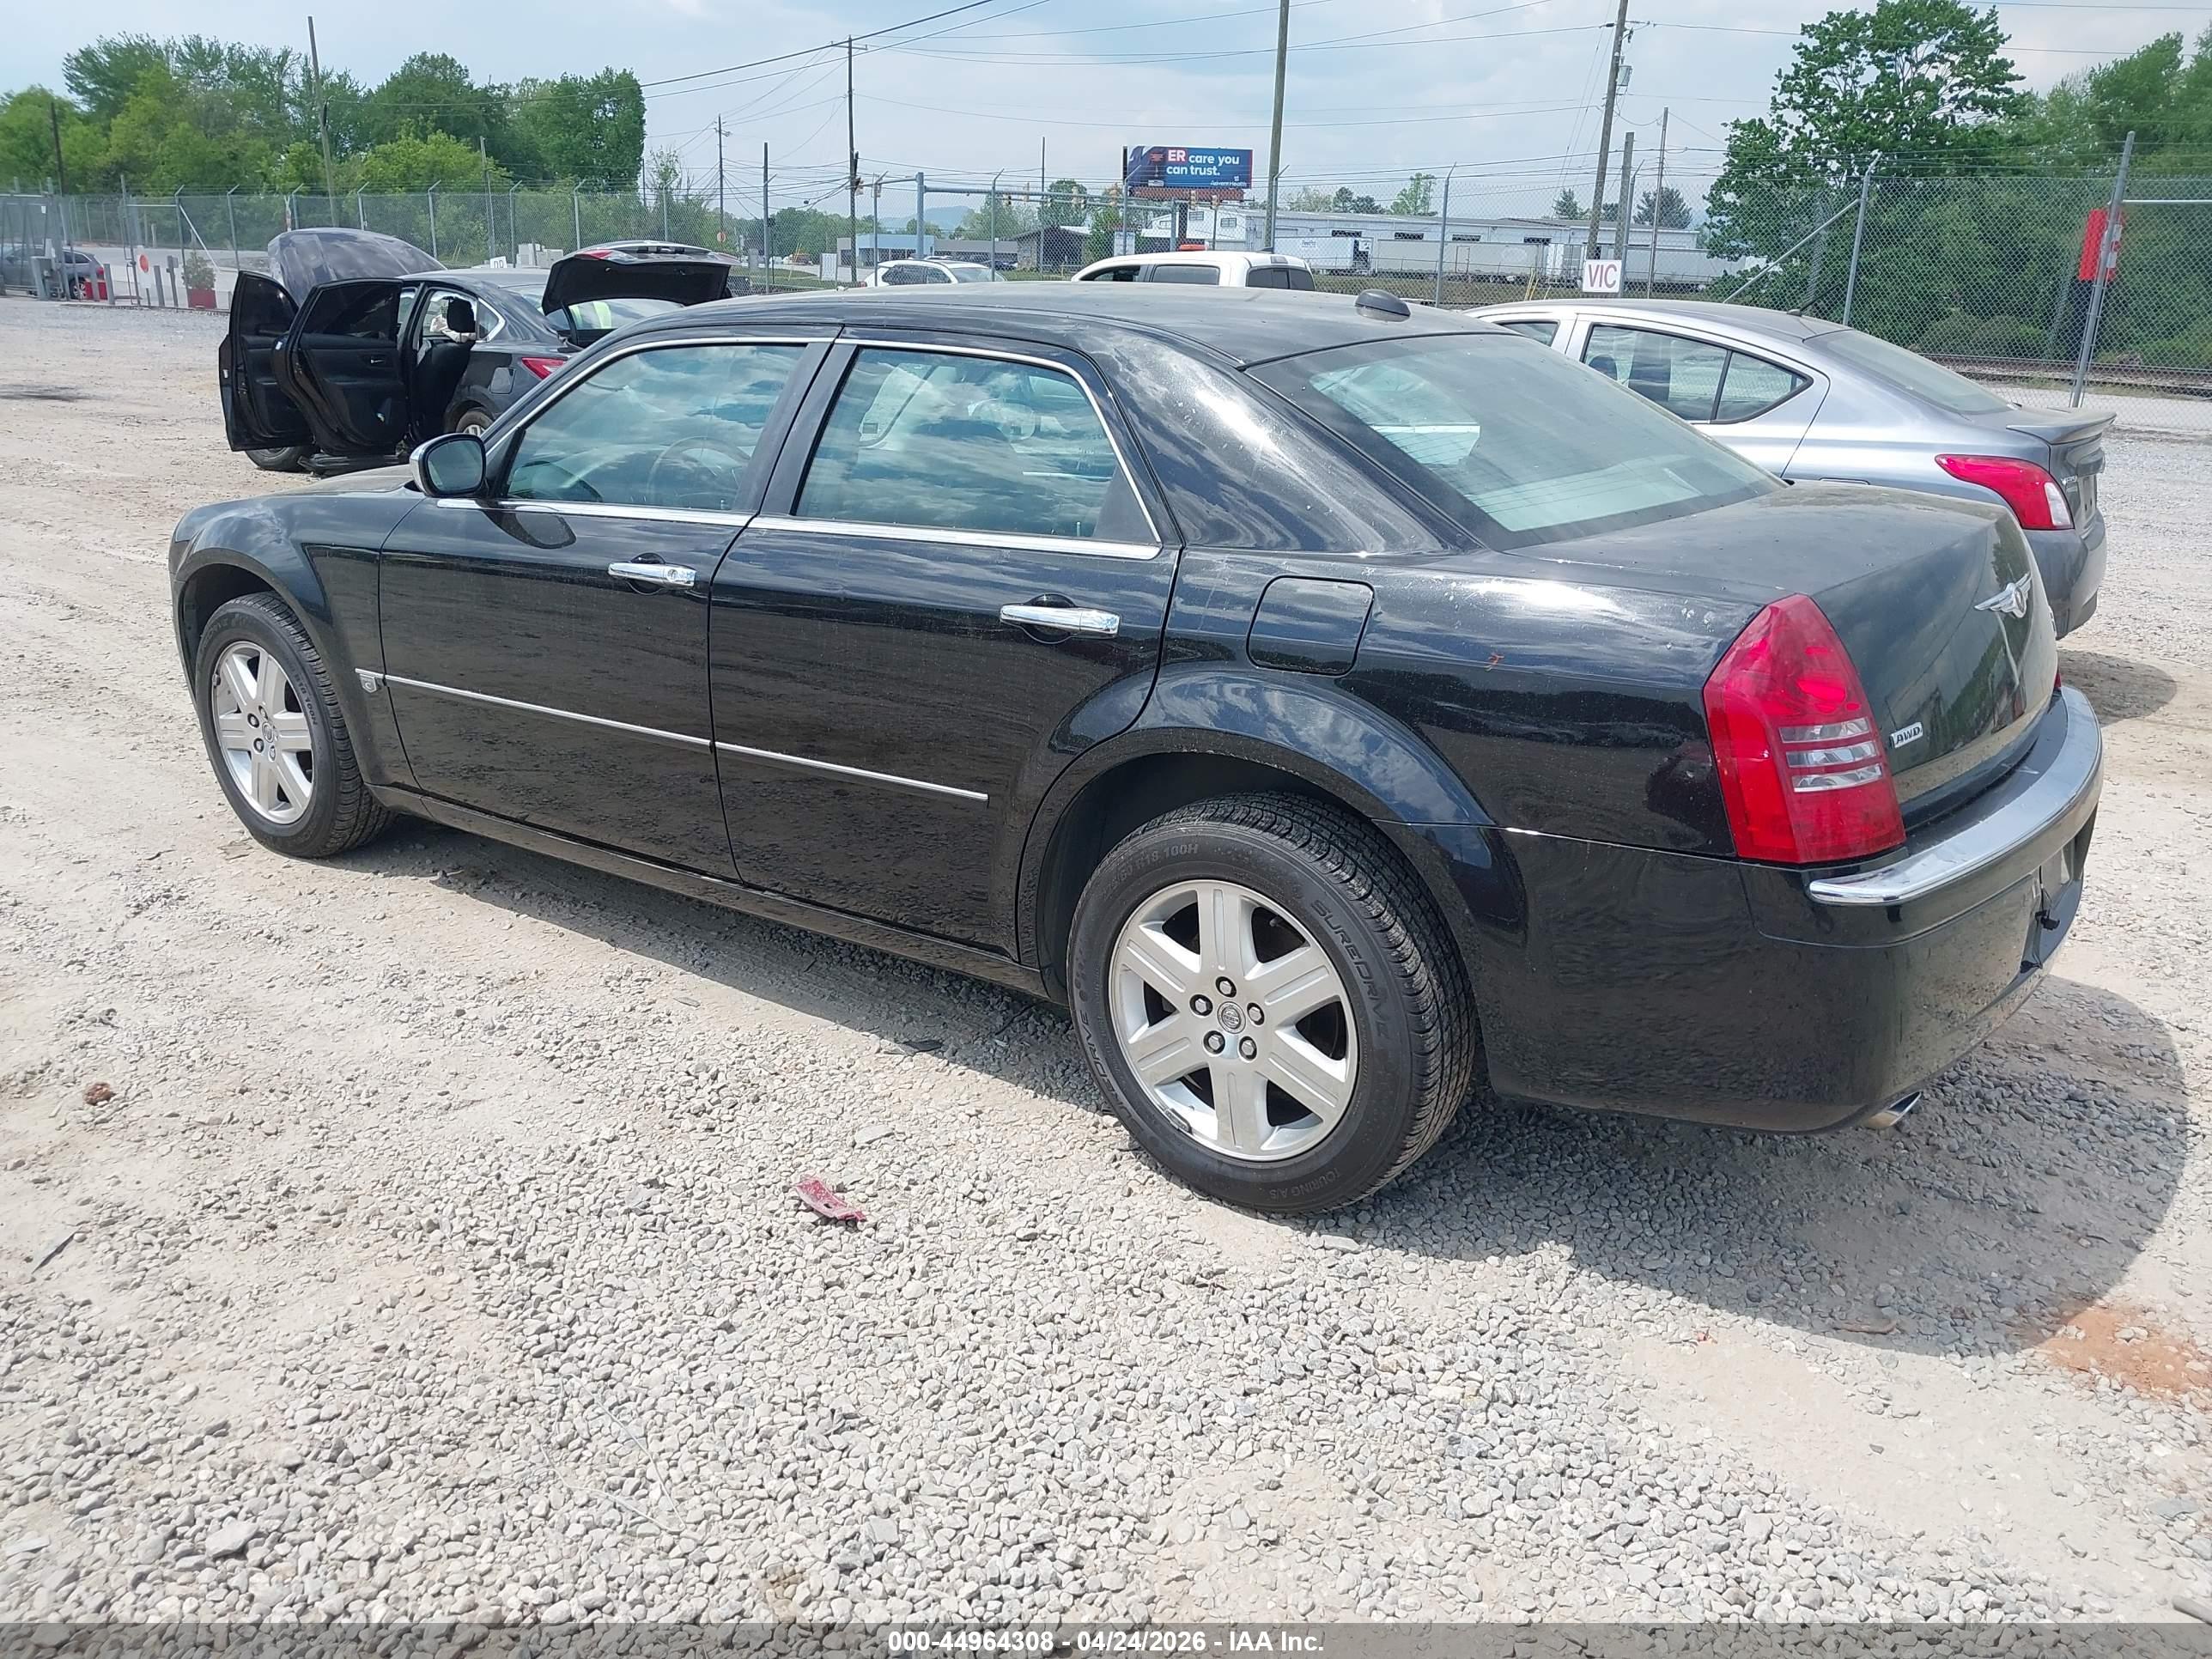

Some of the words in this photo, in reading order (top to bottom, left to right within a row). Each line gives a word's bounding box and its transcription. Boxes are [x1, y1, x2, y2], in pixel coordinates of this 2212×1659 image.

[1168, 149, 1186, 161] ER
[1188, 154, 1214, 164] care
[1218, 155, 1240, 167] you
[1166, 165, 1188, 174] can
[1189, 165, 1221, 175] trust.
[1589, 264, 1617, 289] VIC
[1896, 726, 1921, 744] AWD
[1163, 843, 1199, 859] 100H
[1311, 900, 1391, 1039] SUREDRIVE
